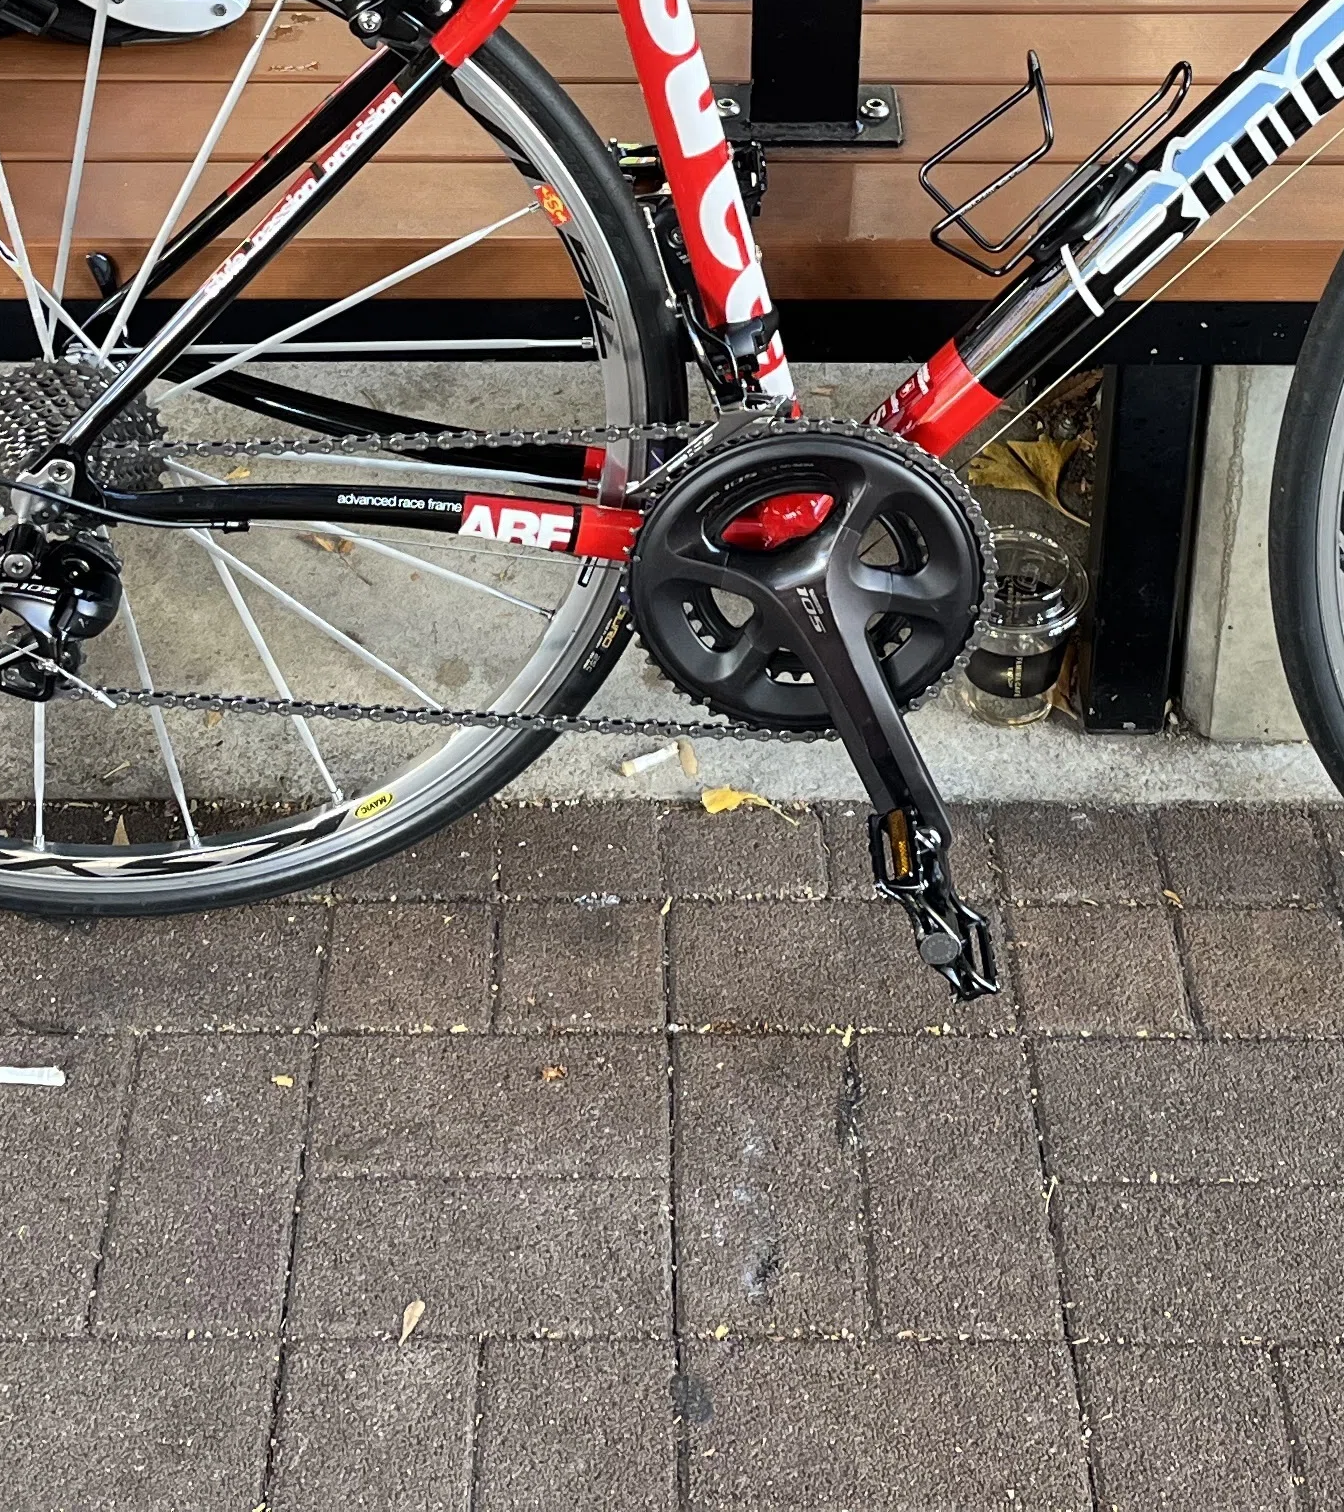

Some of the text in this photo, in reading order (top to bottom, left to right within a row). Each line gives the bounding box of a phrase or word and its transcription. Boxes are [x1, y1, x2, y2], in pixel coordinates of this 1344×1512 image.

[322, 91, 403, 174] precision
[337, 493, 463, 513] advanced race frame
[19, 583, 61, 595] 105
[796, 586, 827, 634] 105
[360, 796, 387, 815] MAVIC
